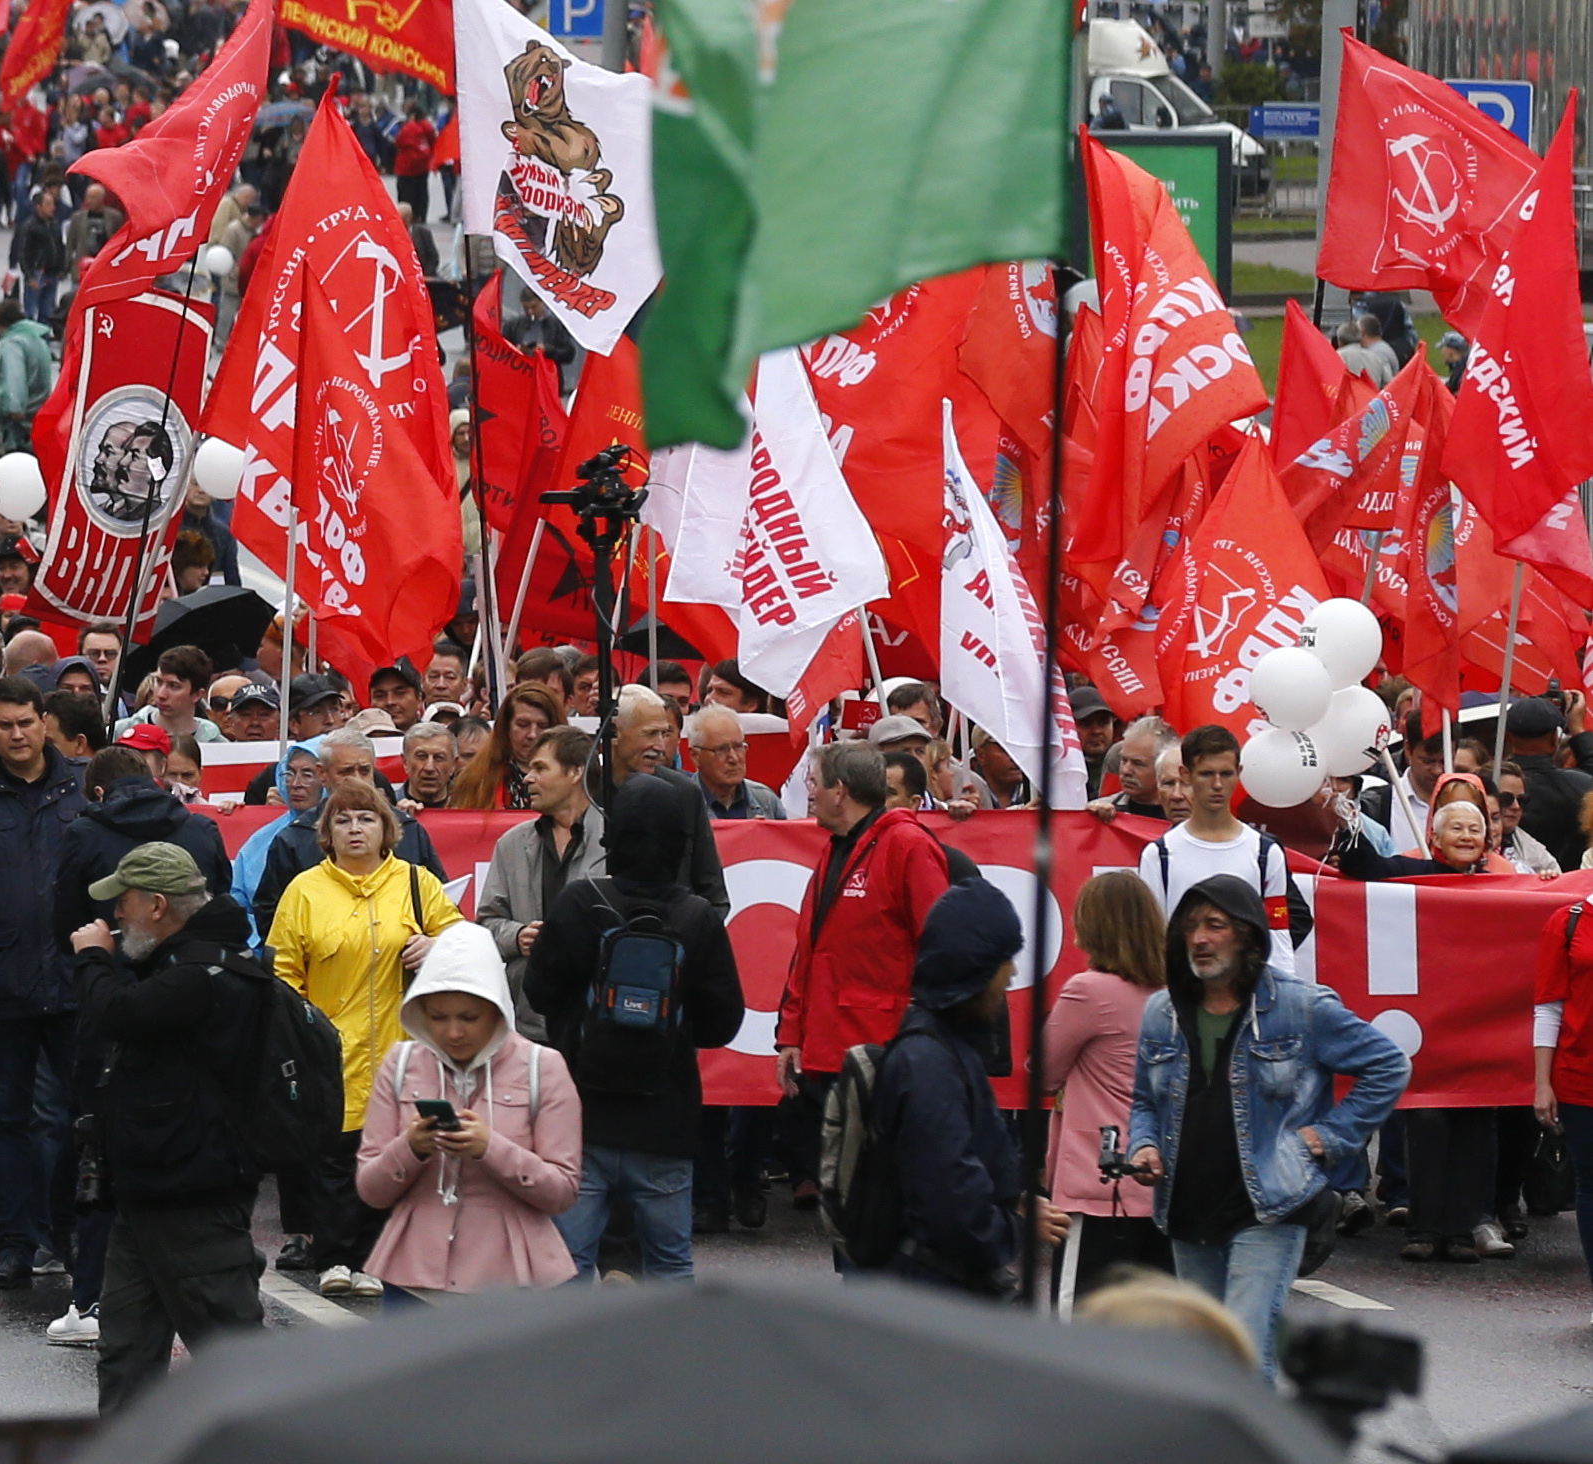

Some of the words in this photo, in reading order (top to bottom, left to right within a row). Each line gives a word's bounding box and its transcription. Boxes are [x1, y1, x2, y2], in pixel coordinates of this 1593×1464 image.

[315, 204, 370, 233] ТРУД
[268, 246, 307, 331] РОССИЯ
[818, 335, 878, 388] ПРФ
[330, 377, 384, 469] НАРОДОВЛАСТИЕ
[751, 436, 839, 600] РОДНЫЙ
[843, 888, 866, 899] КПРФ
